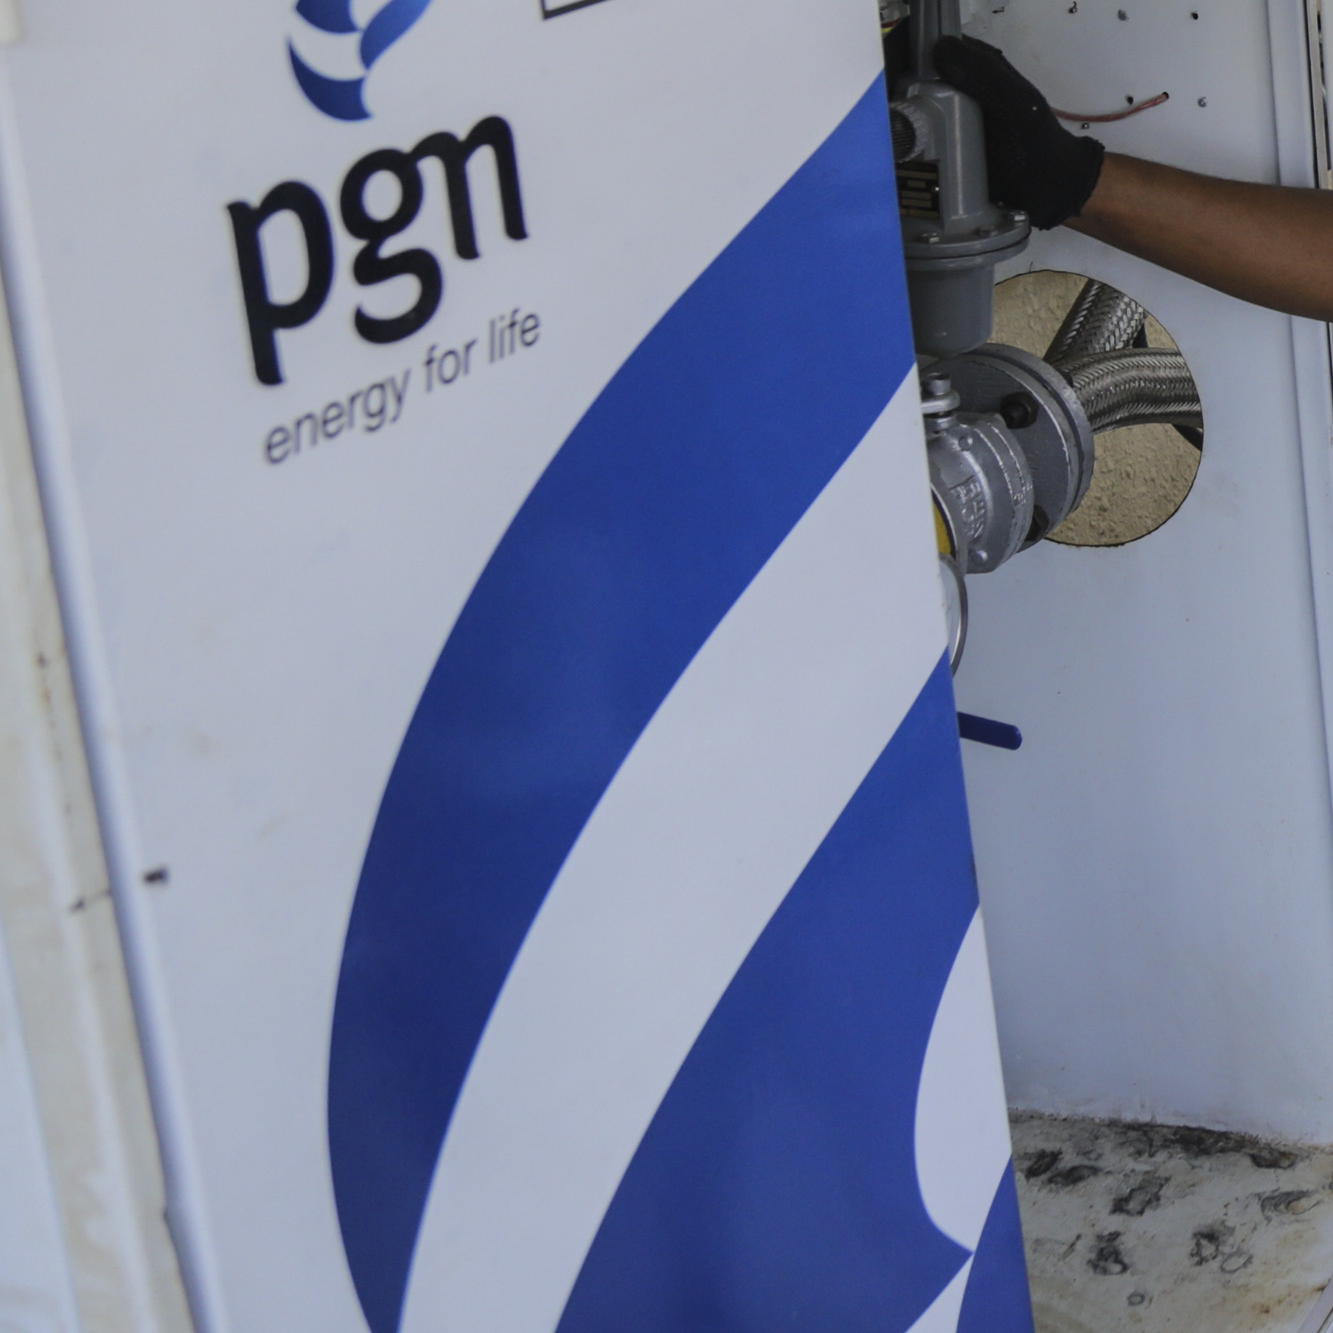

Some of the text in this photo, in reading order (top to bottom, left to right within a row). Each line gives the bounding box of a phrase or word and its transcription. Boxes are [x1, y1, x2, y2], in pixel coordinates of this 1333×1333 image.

[226, 115, 528, 386] pgn
[263, 307, 541, 465] energy for life
